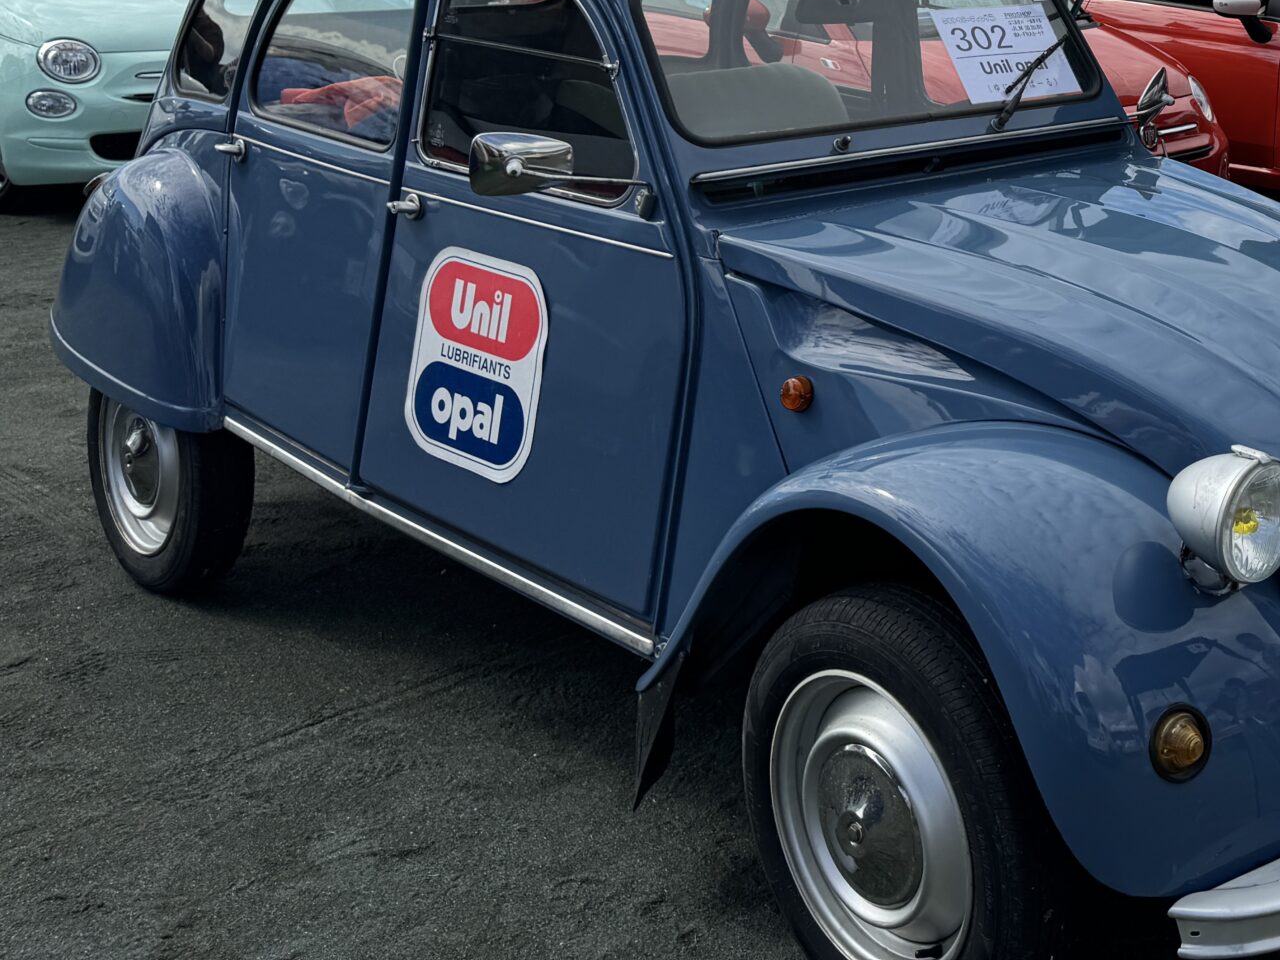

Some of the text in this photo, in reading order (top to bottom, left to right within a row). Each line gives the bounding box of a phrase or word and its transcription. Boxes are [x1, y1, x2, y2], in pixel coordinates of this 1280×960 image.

[950, 24, 1013, 52] 302
[979, 58, 1013, 75] Unil
[450, 277, 513, 344] Unil
[440, 342, 512, 380] LUBRIFIANTS
[430, 386, 505, 445] opal
